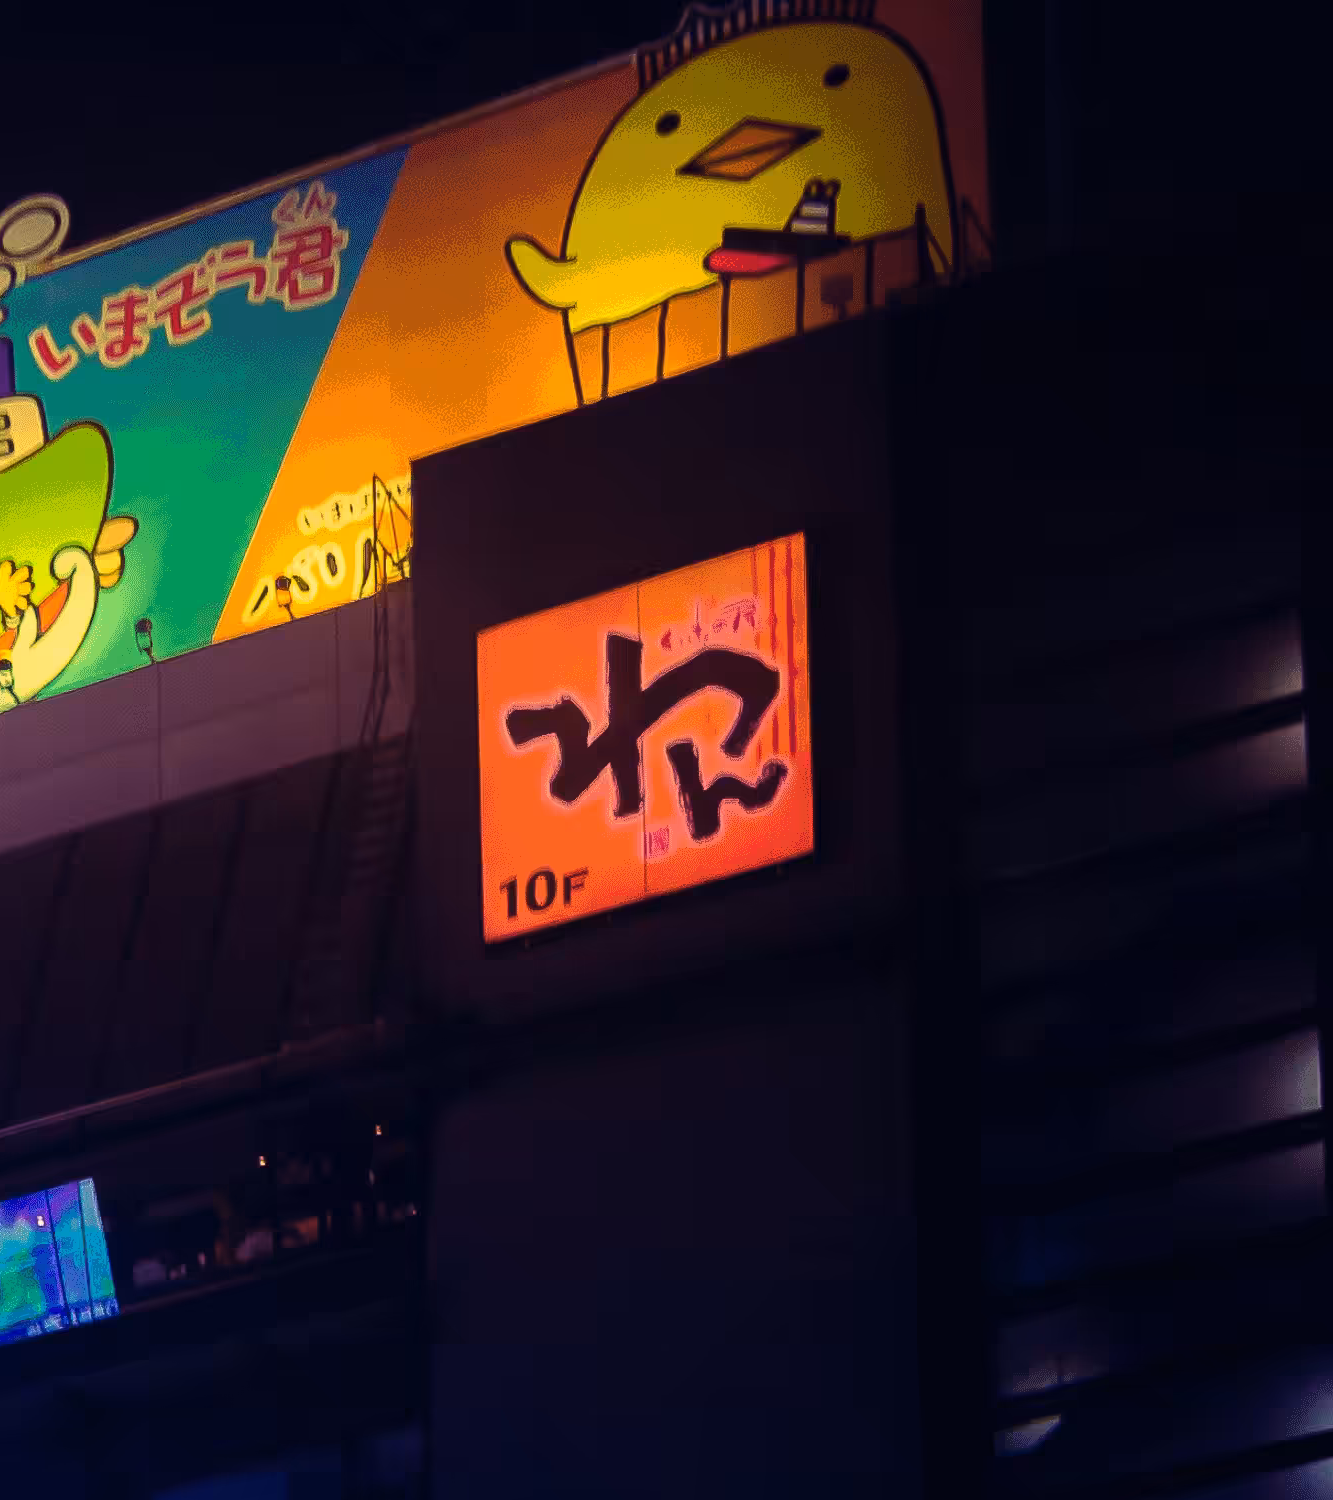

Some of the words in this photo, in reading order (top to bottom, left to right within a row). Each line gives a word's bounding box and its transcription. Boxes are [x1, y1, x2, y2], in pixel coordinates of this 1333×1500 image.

[29, 222, 349, 381] いまぞう君
[500, 865, 589, 921] 10F
